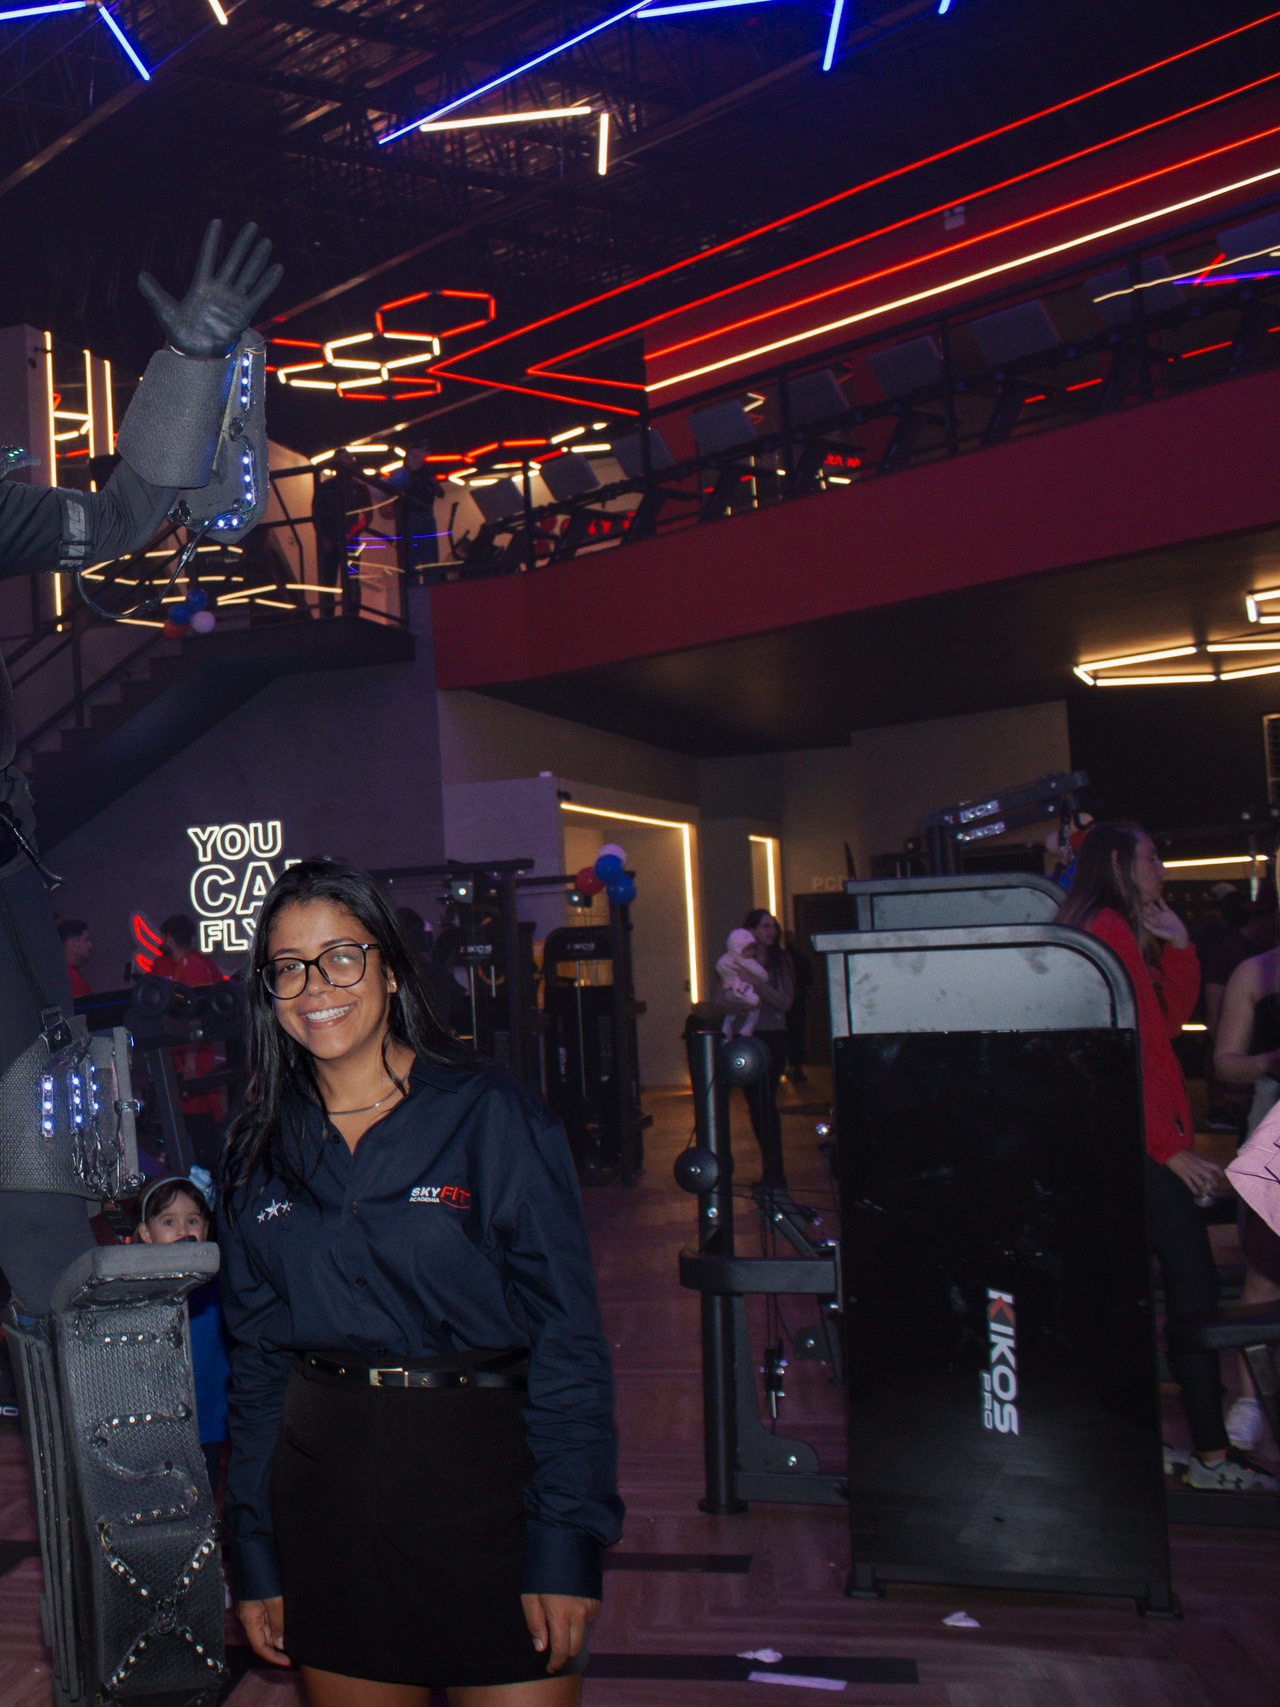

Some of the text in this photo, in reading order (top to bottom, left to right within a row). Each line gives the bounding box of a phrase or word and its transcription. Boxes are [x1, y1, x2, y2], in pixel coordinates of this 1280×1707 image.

[187, 821, 282, 862] YOU
[190, 859, 302, 917] CA
[987, 1287, 1019, 1436] KIKOS
[982, 1371, 993, 1430] PRO
